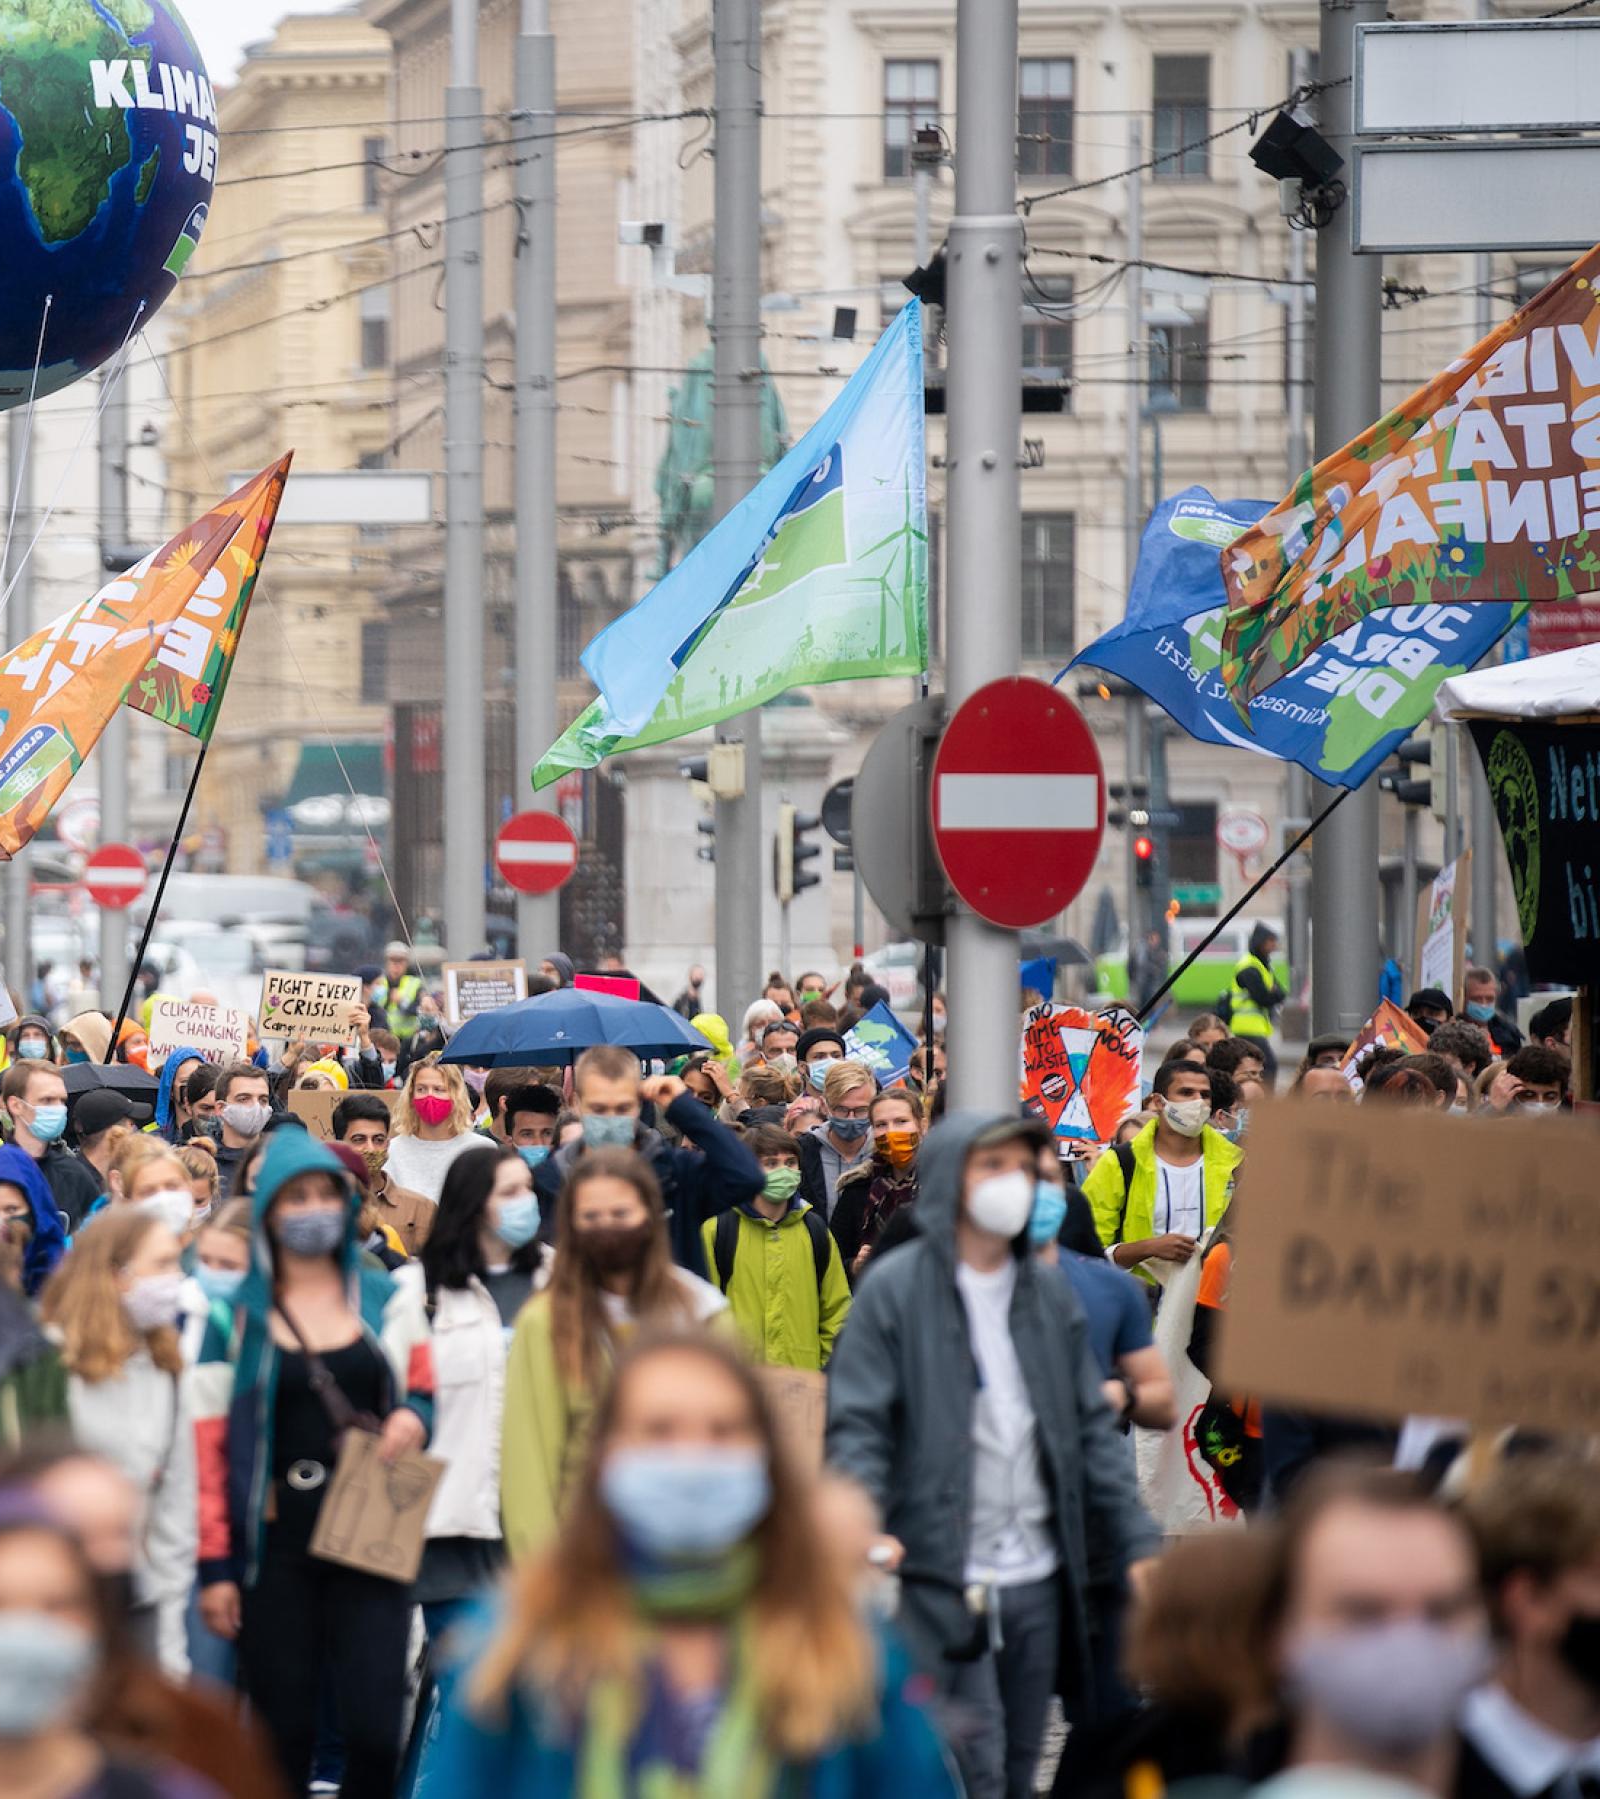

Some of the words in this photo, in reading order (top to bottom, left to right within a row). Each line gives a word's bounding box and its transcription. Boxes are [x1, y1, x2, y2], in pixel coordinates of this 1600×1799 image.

[268, 977, 313, 998] FIGHT
[316, 982, 360, 1001] EVERY
[159, 1002, 216, 1021] CLIMATE
[226, 1009, 238, 1025] IS
[1029, 1002, 1053, 1022] NO
[1098, 1008, 1141, 1037] ACT
[175, 1020, 242, 1043] CHANGING
[1024, 1019, 1060, 1045] TIME
[1035, 1041, 1055, 1058] TO
[1100, 1029, 1140, 1060] NOW
[1024, 1052, 1069, 1072] WASTE
[1280, 1232, 1503, 1330] DAMN
